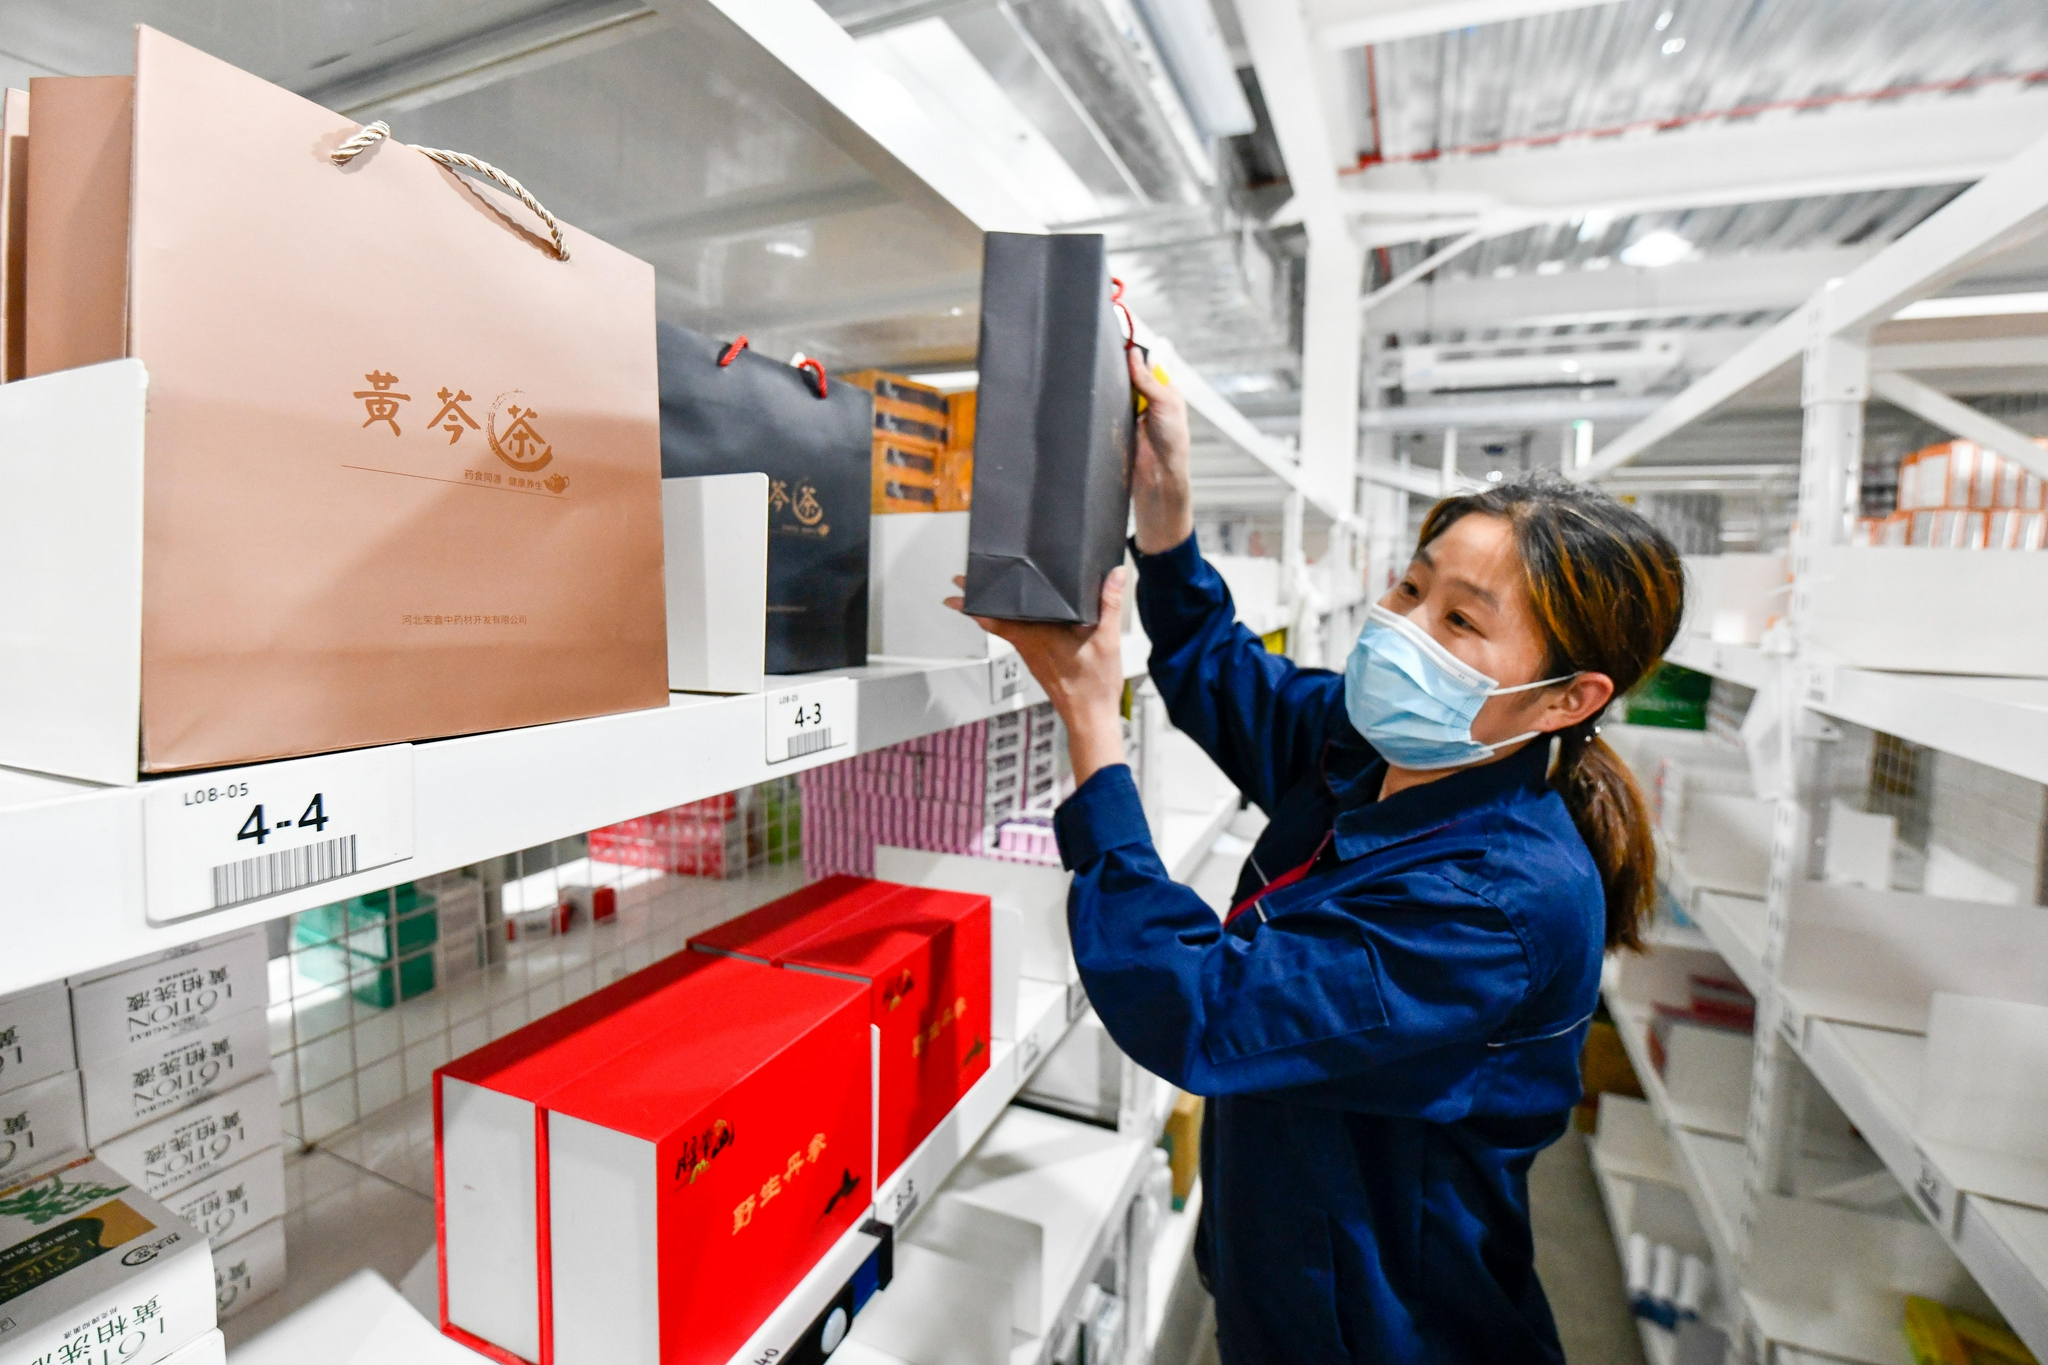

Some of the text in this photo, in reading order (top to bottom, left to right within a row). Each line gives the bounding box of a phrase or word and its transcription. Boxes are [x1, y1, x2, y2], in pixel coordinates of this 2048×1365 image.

[402, 614, 527, 626] 河北荣鑫中药材开发有限公司
[795, 703, 822, 727] 4-3
[184, 782, 249, 806] L08-05
[237, 793, 329, 844] 4-4
[127, 984, 233, 1032] LOTION
[134, 1053, 234, 1107] LOTION
[146, 1127, 244, 1184] LOTION
